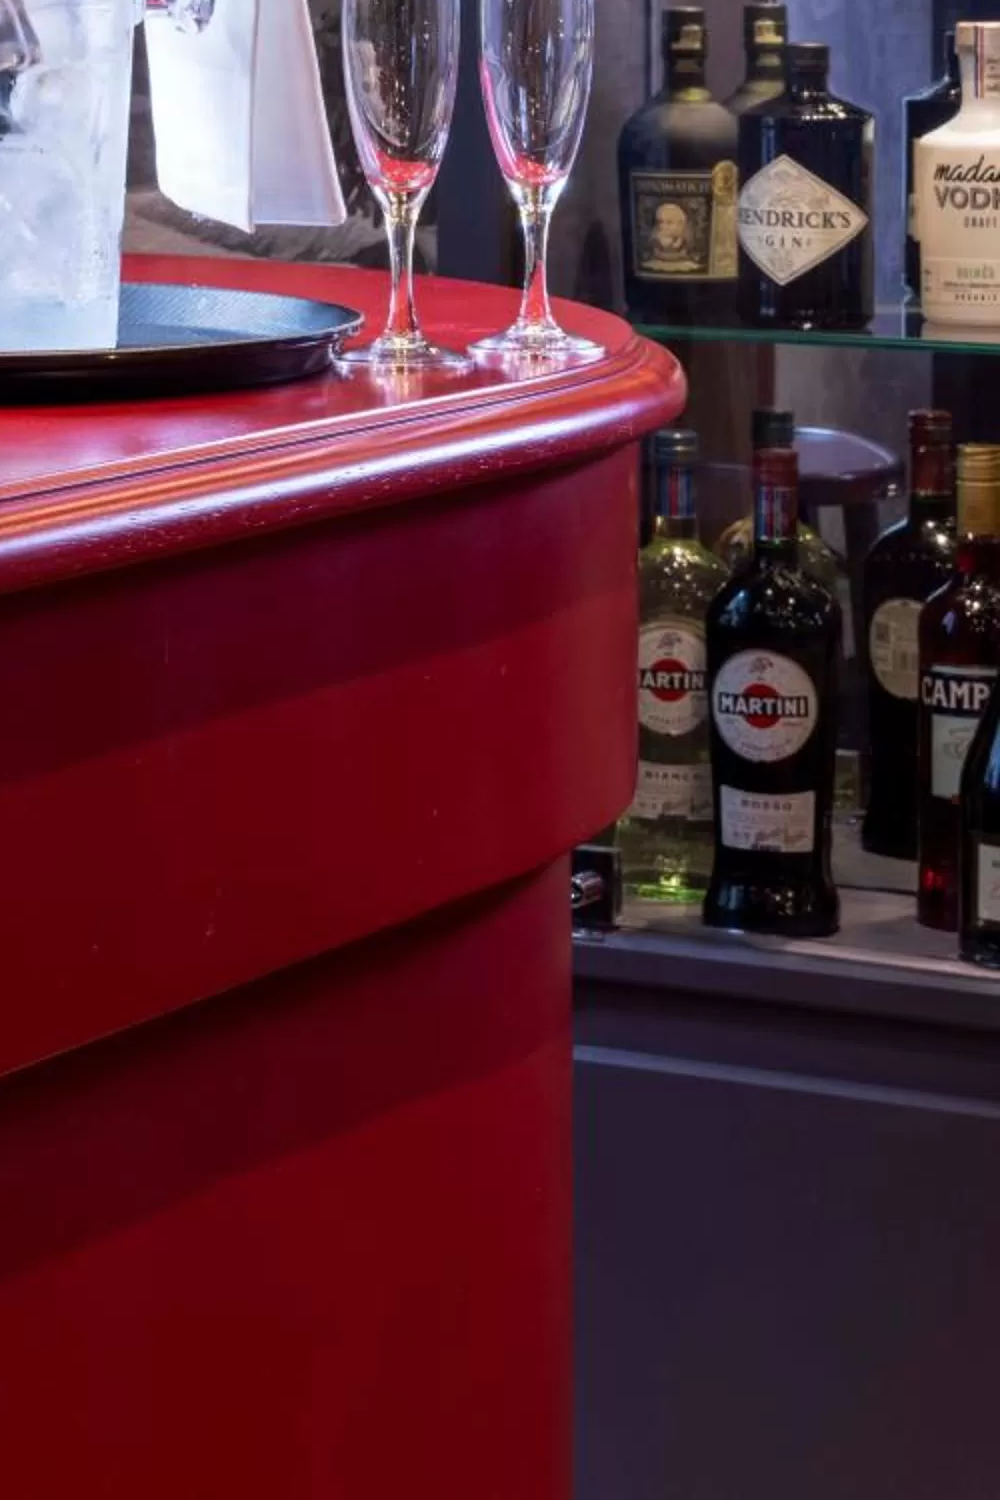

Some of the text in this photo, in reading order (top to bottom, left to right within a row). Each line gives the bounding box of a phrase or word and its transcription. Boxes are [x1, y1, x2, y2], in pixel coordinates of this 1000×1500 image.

[932, 153, 1000, 183] mada
[765, 234, 802, 248] GIN
[641, 670, 706, 691] ARTIN
[921, 676, 991, 710] CAMP
[720, 694, 807, 716] MARTINI
